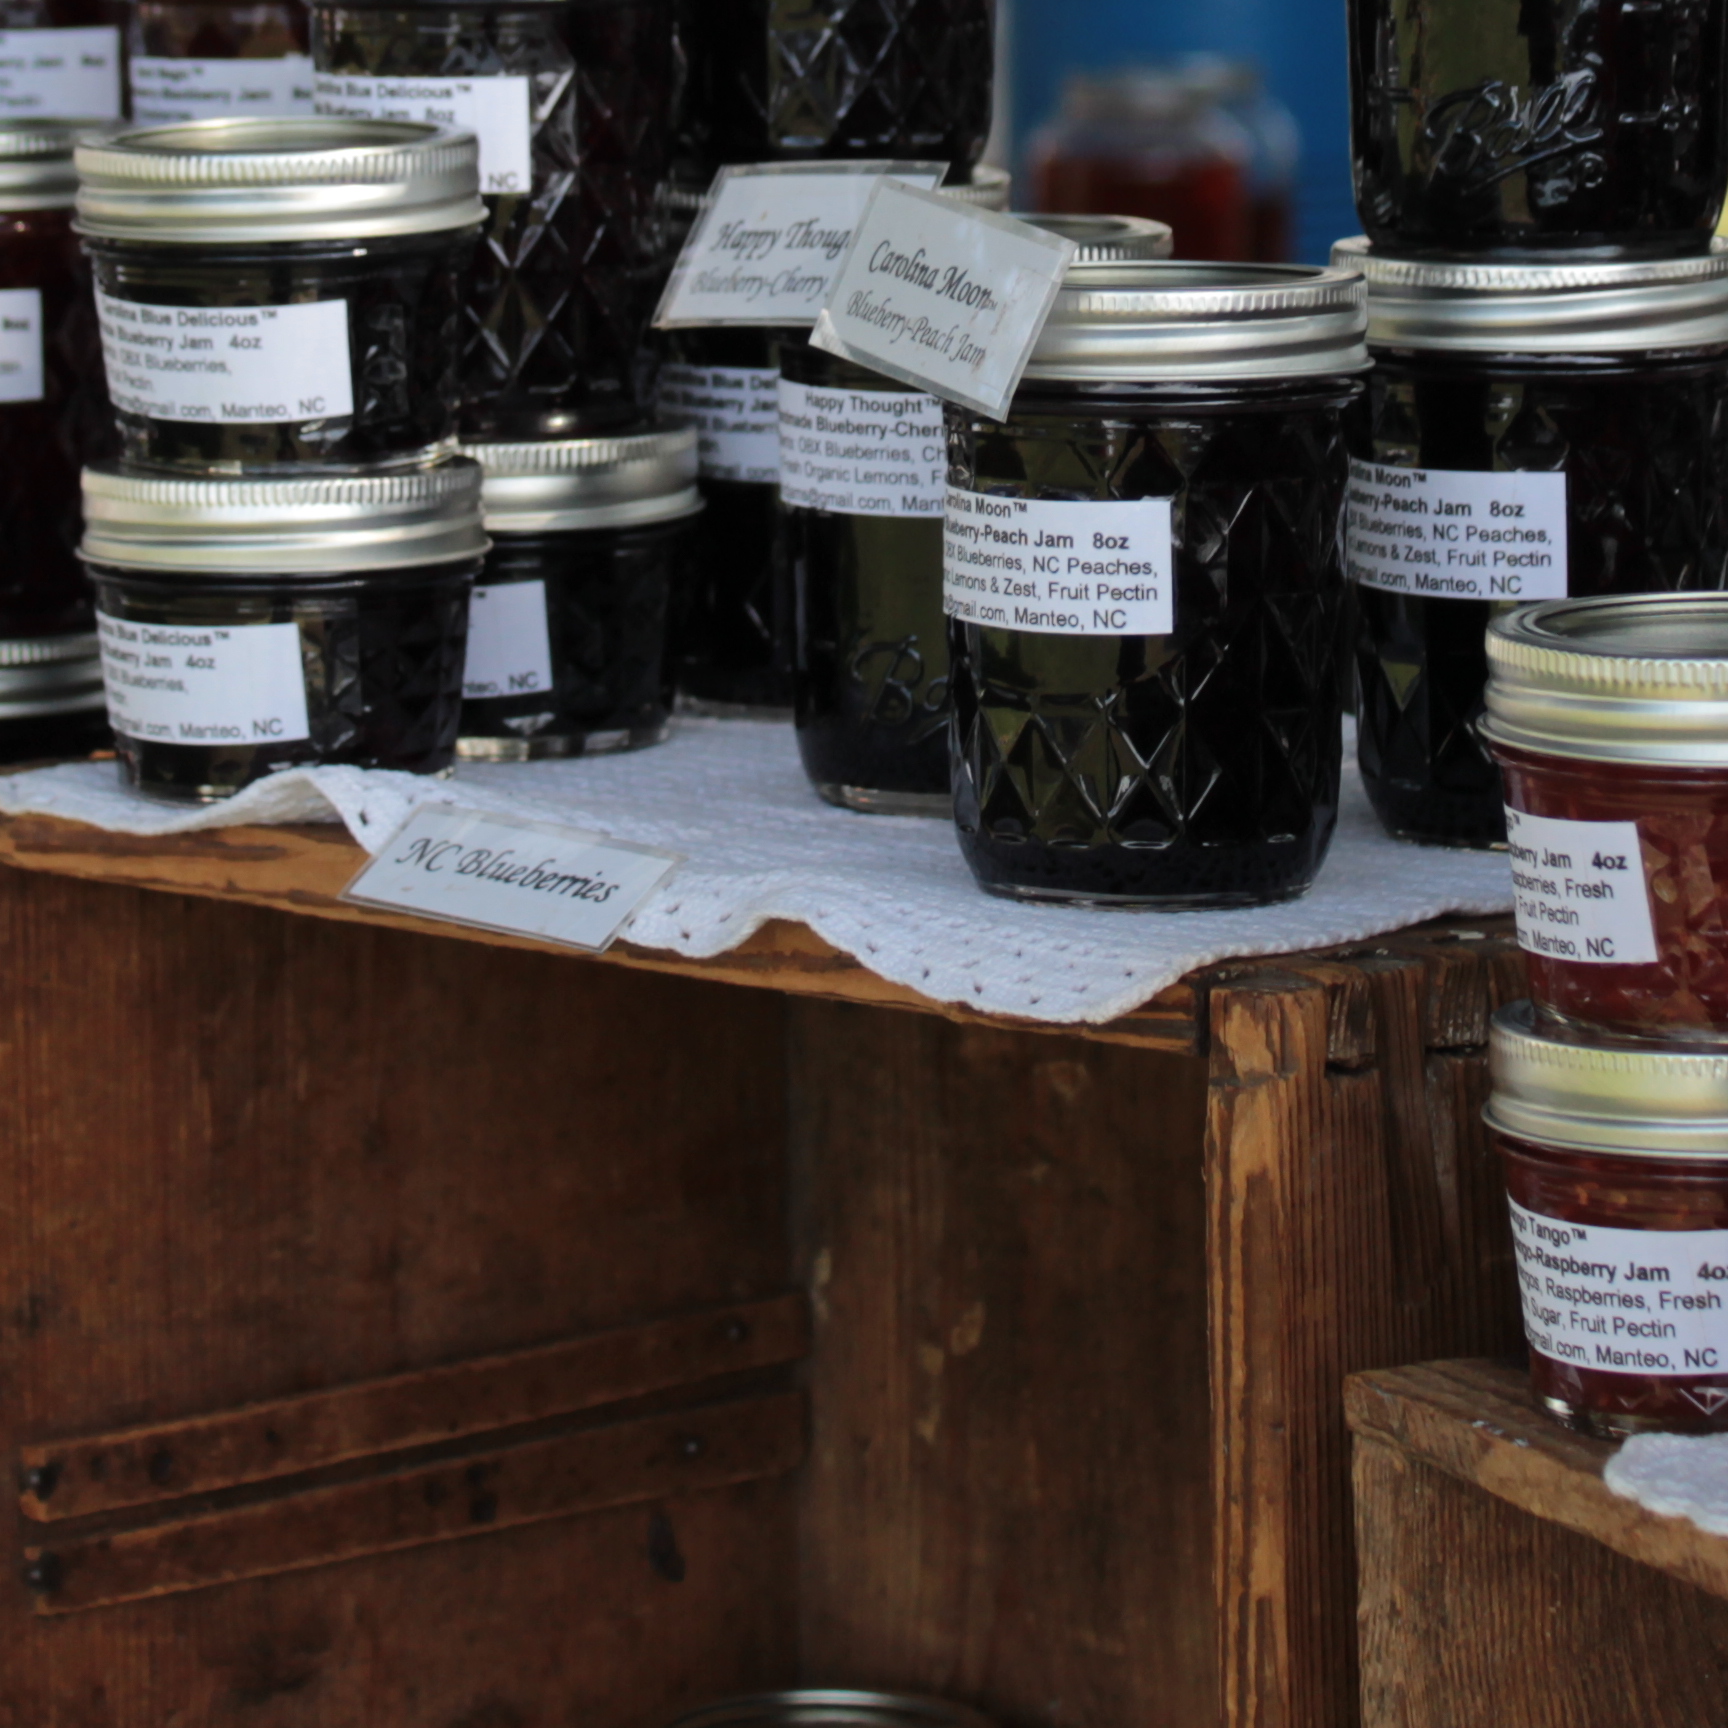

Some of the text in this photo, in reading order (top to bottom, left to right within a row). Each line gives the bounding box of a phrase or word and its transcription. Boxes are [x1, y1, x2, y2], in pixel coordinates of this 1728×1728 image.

[489, 173, 518, 190] NC
[711, 220, 782, 259] Happy
[868, 240, 939, 291] Carolina
[690, 271, 827, 302] Blueberry-Cherry
[142, 309, 172, 324] Blue
[180, 335, 261, 349] Jam 4oz
[846, 292, 986, 372] Blueberry-Peach Jam
[221, 397, 325, 418] Manteo, NC
[806, 392, 843, 413] Happy
[826, 442, 914, 463] Blueberries,
[854, 467, 923, 486] Lemons,
[1433, 499, 1524, 517] Jam 8oz
[1034, 531, 1130, 550] Jam 8oz
[1433, 525, 1552, 544] NC Peaches,
[958, 546, 1158, 577] Blueberries, NC Peaches,
[1391, 545, 1551, 567] & Zest, Fruit Pectin
[952, 570, 1157, 601] Lemons & Zest, Fruit Pectin
[1416, 573, 1521, 596] Manteo, NC
[1015, 607, 1127, 631] Manteo, NC
[145, 653, 215, 668] Jam 4oz
[509, 672, 538, 691] NC
[253, 719, 282, 736] NC
[395, 837, 620, 903] NC Blueberries
[1542, 848, 1628, 870] Jam 4oz
[1565, 879, 1614, 899] Fresh
[1520, 896, 1579, 925] Fruit Pectin
[1532, 931, 1615, 959] Manteo, NC
[1624, 1263, 1670, 1282] Jam
[1546, 1282, 1721, 1312] Raspberries, Fresh
[1531, 1298, 1676, 1338] Sugar, Fruit Pectin
[1596, 1344, 1718, 1371] Manteo, NC
